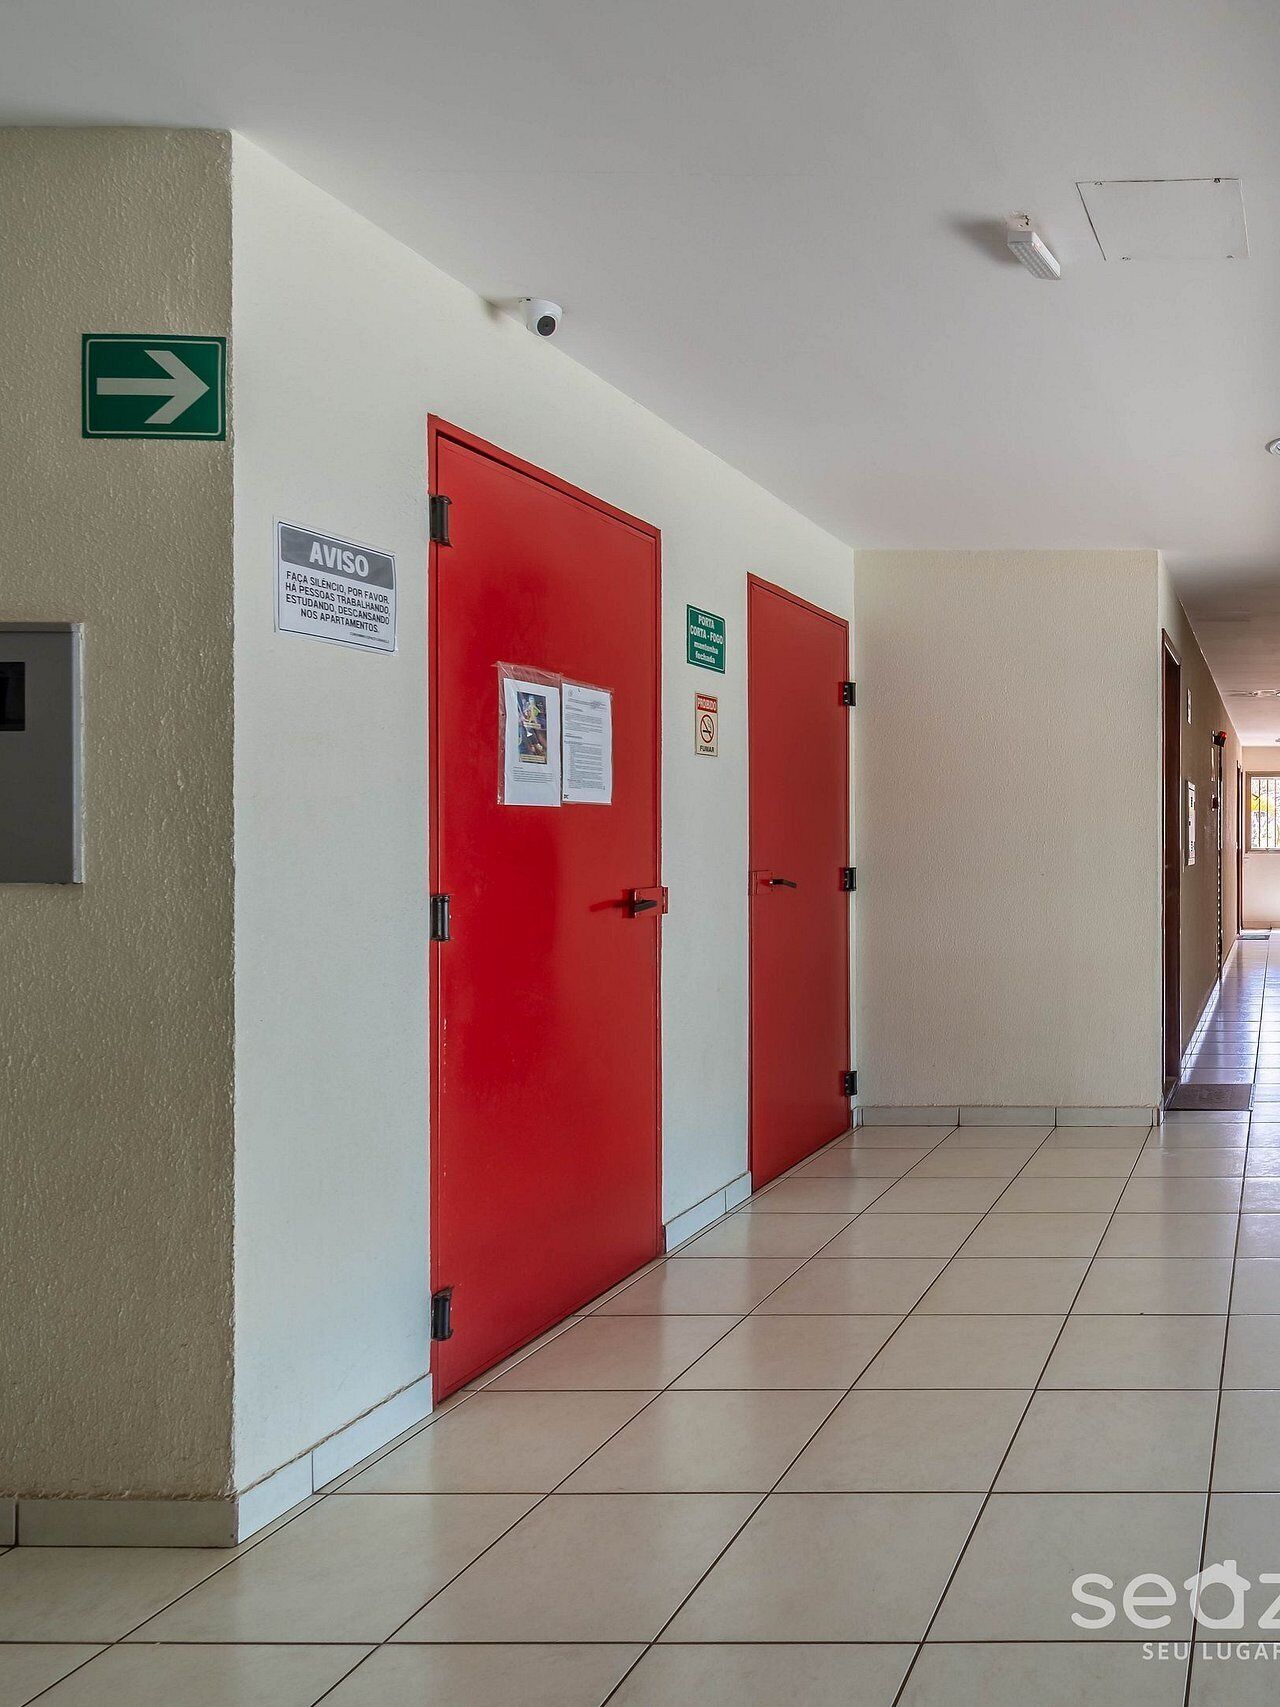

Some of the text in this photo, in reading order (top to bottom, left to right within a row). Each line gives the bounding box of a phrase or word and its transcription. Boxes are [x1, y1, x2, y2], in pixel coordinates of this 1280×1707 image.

[309, 541, 369, 577] AVISO
[285, 581, 297, 592] HÁ
[299, 585, 335, 602] PESSOAS
[286, 570, 308, 585] FAÇA
[347, 586, 363, 598] POR
[286, 593, 390, 626] ESTUDANDO, DESCANSANDO
[300, 608, 318, 620] NOS
[698, 614, 715, 630] PORTA
[690, 624, 707, 640] CORTA
[709, 631, 724, 645] FOGO
[699, 745, 715, 753] FUMAR
